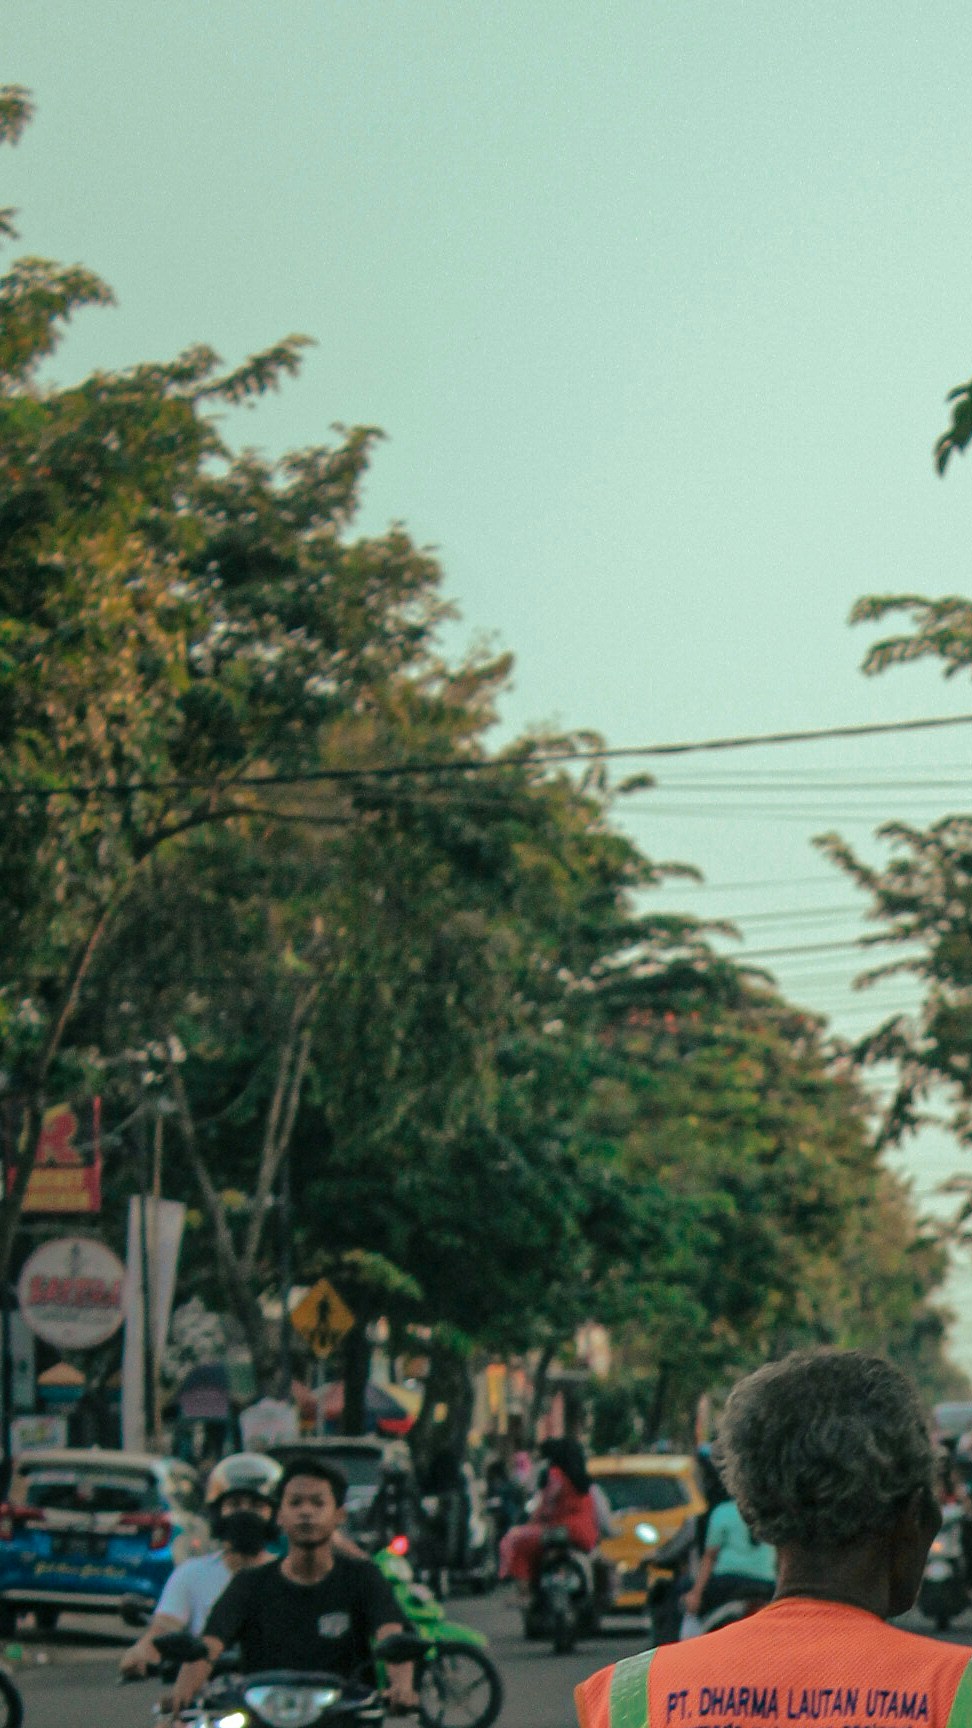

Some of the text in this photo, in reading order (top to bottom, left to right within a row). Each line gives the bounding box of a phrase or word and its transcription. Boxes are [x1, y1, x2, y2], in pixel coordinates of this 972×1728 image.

[666, 1686, 928, 1725] PT. DHARMA LAUTAN UTAMA
